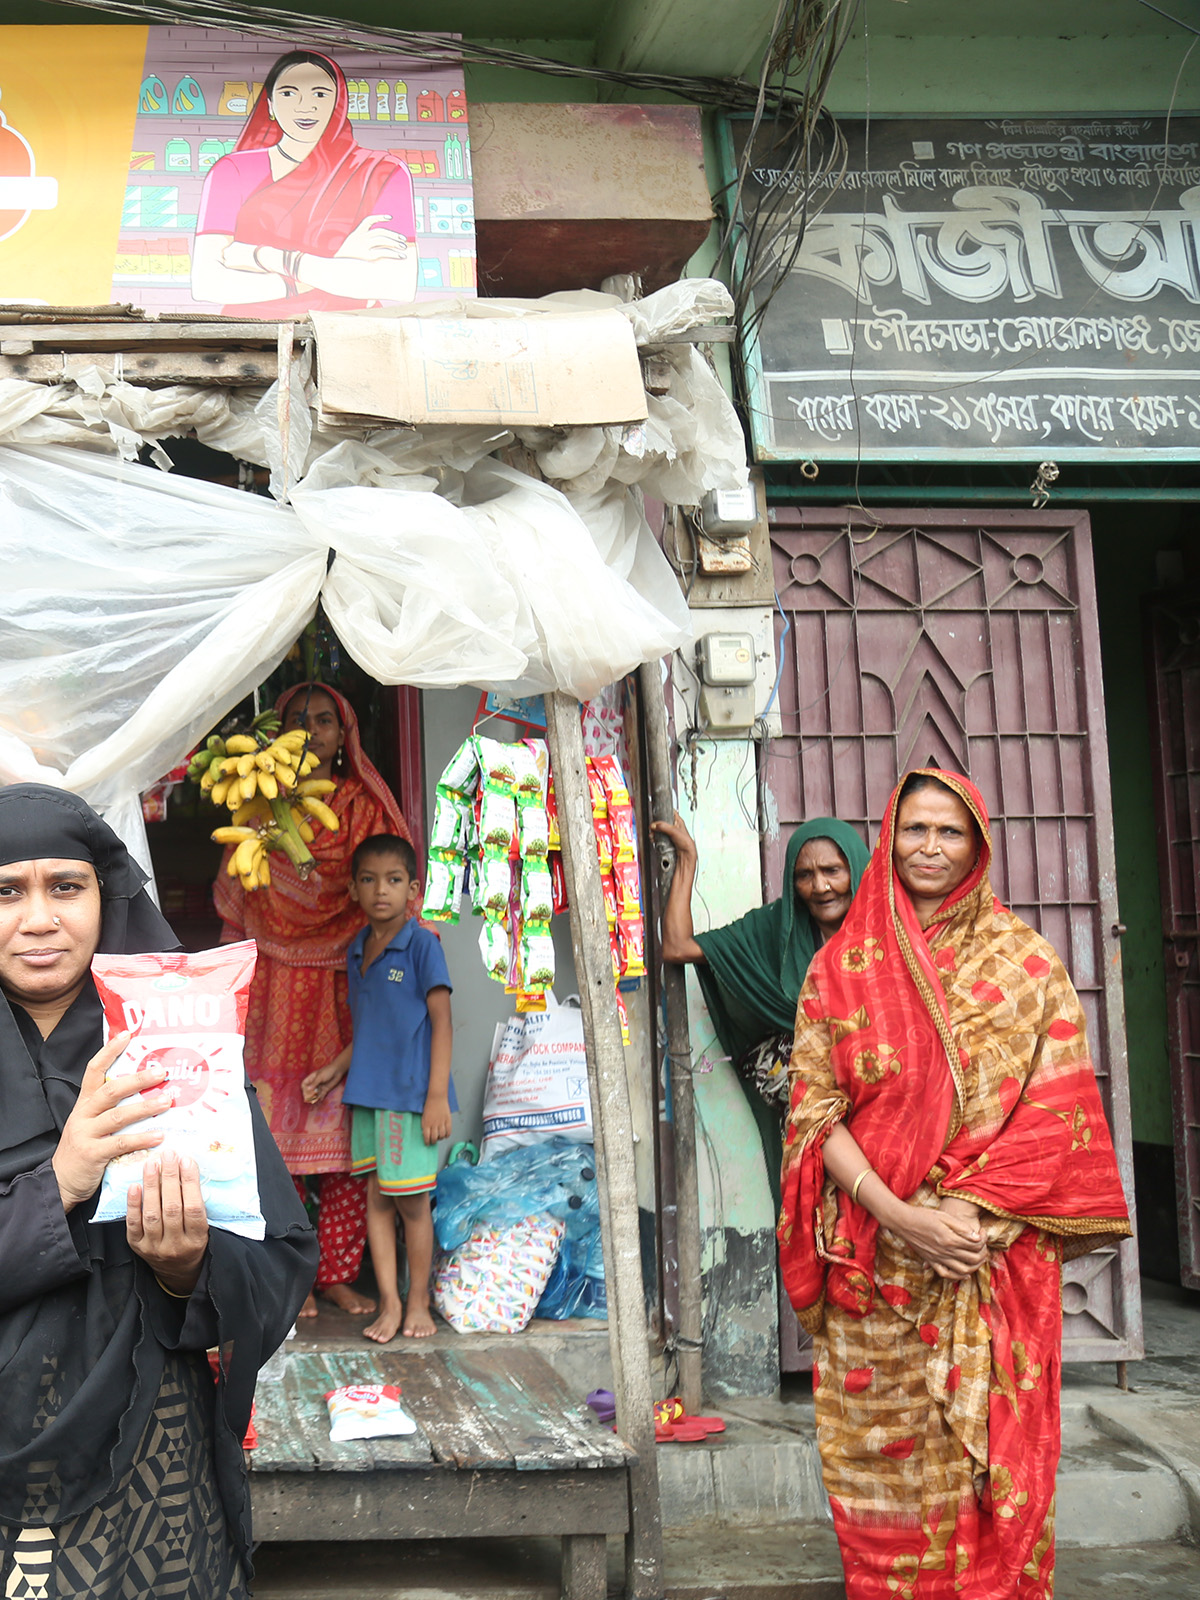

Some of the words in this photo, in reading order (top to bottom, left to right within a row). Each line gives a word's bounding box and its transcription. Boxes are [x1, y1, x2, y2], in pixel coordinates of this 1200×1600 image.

[1116, 162, 1152, 188] নারী
[740, 185, 1064, 306] কাজী
[788, 395, 854, 441] বরের
[1044, 394, 1114, 441] কনের
[388, 969, 404, 983] 32
[122, 993, 221, 1034] DANO
